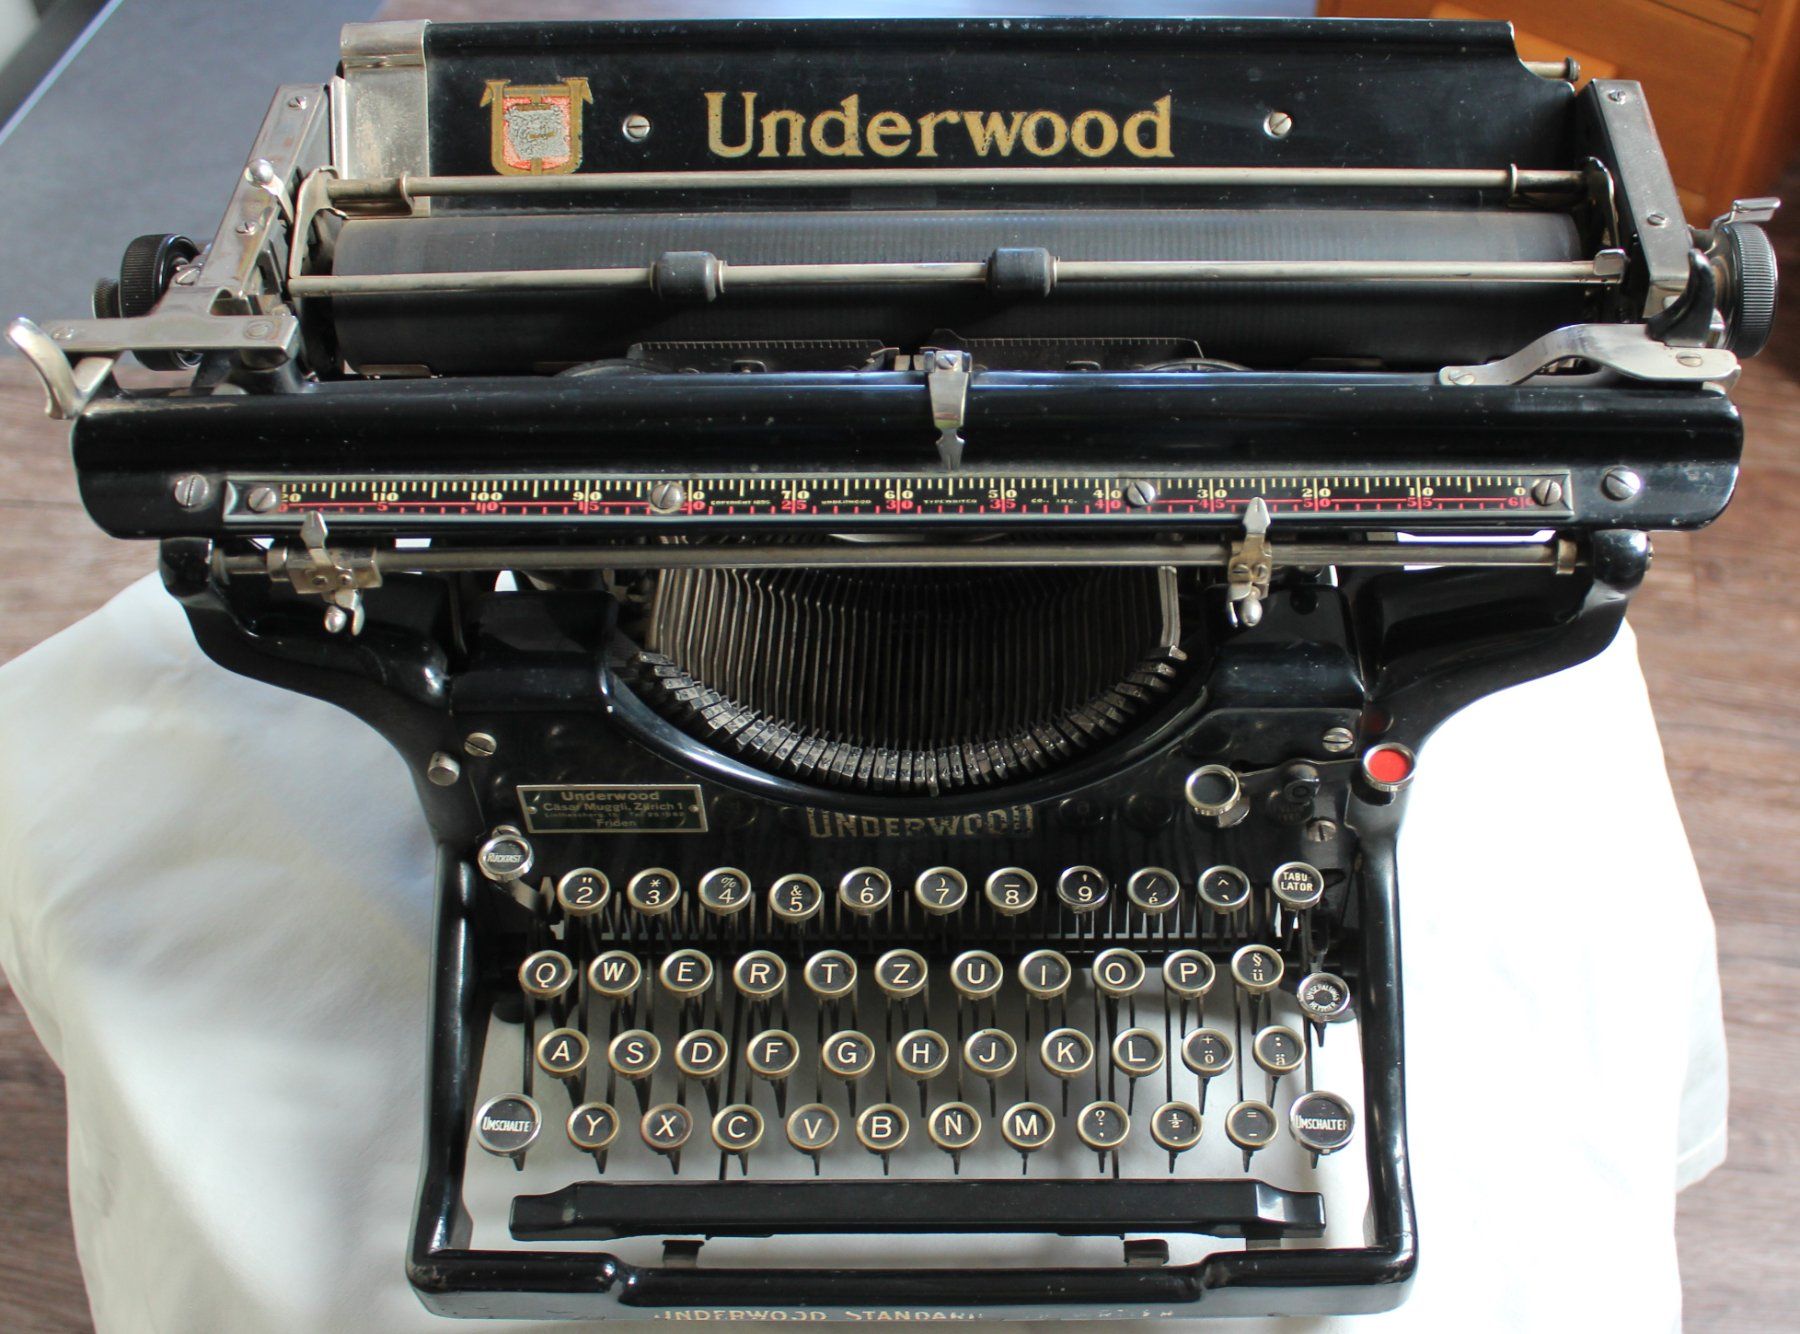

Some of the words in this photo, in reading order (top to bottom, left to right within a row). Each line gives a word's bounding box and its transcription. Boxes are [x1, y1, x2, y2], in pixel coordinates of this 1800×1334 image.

[704, 91, 1174, 159] Underwood
[377, 502, 390, 512] 5
[781, 500, 809, 511] 25
[886, 500, 914, 510] 30
[990, 499, 1017, 510] 35
[1095, 499, 1122, 509] 40
[1199, 499, 1225, 509] 45
[1303, 498, 1332, 508] 50
[1407, 497, 1434, 508] 55
[471, 491, 503, 502] 100
[573, 490, 602, 501] 90
[781, 489, 810, 500] 70
[884, 489, 914, 500] 60
[988, 489, 1018, 499] 50
[1092, 488, 1123, 498] 40
[1197, 488, 1228, 498] 30
[1301, 488, 1332, 498] 20
[1408, 487, 1435, 497] 10
[561, 791, 660, 801] Underwood
[576, 886, 594, 904] 2
[646, 889, 662, 905] 3
[718, 886, 735, 904] 4
[860, 885, 875, 904] 6
[935, 888, 951, 905] 7
[1004, 888, 1020, 905] 8
[1078, 885, 1094, 902] 9
[1280, 881, 1314, 892] LATOR
[788, 896, 804, 912] 5
[535, 962, 556, 989] Q
[602, 961, 627, 982] W
[677, 961, 696, 982] E
[750, 963, 771, 984] R
[821, 963, 839, 984] T
[892, 963, 911, 984] Z
[967, 963, 986, 984] U
[1041, 964, 1046, 986] I
[1102, 962, 1126, 986] O
[1179, 962, 1198, 983] P
[551, 1038, 571, 1062] A
[625, 1041, 644, 1064] S
[691, 1042, 713, 1063] D
[765, 1042, 784, 1063] F
[837, 1041, 857, 1064] G
[912, 1042, 930, 1064] H
[978, 1042, 996, 1063] J
[1057, 1042, 1075, 1064] K
[1127, 1040, 1146, 1062] L
[1204, 1050, 1214, 1063] ö
[1275, 1053, 1286, 1067] ä
[585, 1114, 604, 1136] Y
[655, 1114, 677, 1137] X
[727, 1115, 748, 1138] C
[804, 1118, 823, 1139] V
[871, 1116, 892, 1138] B
[944, 1114, 962, 1136] N
[1015, 1114, 1038, 1137] M
